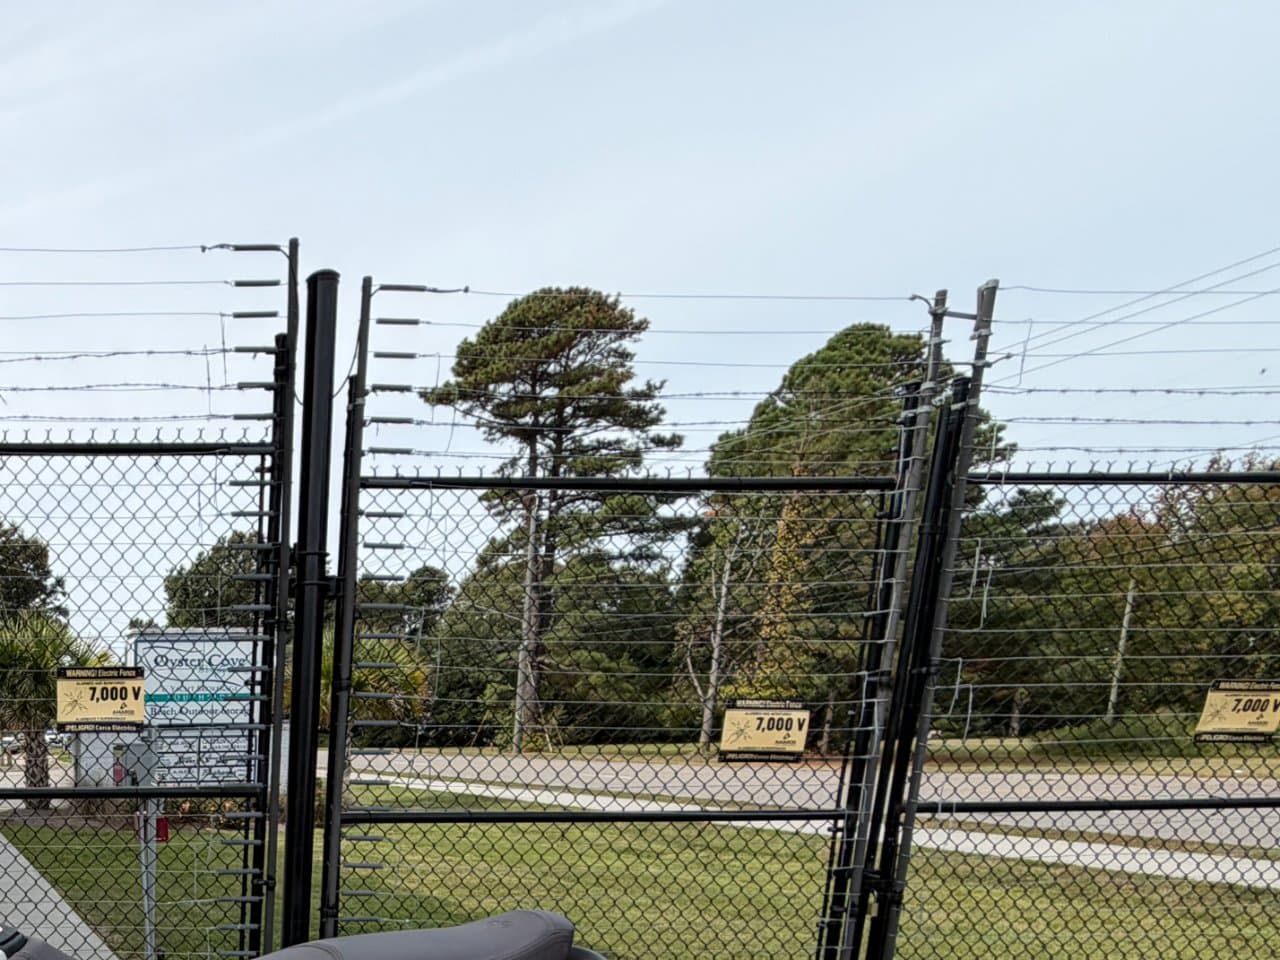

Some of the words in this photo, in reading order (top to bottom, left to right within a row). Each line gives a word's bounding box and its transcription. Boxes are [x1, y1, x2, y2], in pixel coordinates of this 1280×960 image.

[154, 654, 202, 668] Oyster
[208, 653, 246, 667] Cove
[89, 686, 128, 703] 7,000
[132, 686, 141, 701] V
[1232, 698, 1270, 713] 7,000
[756, 717, 793, 732] 7,000
[797, 717, 806, 732] V
